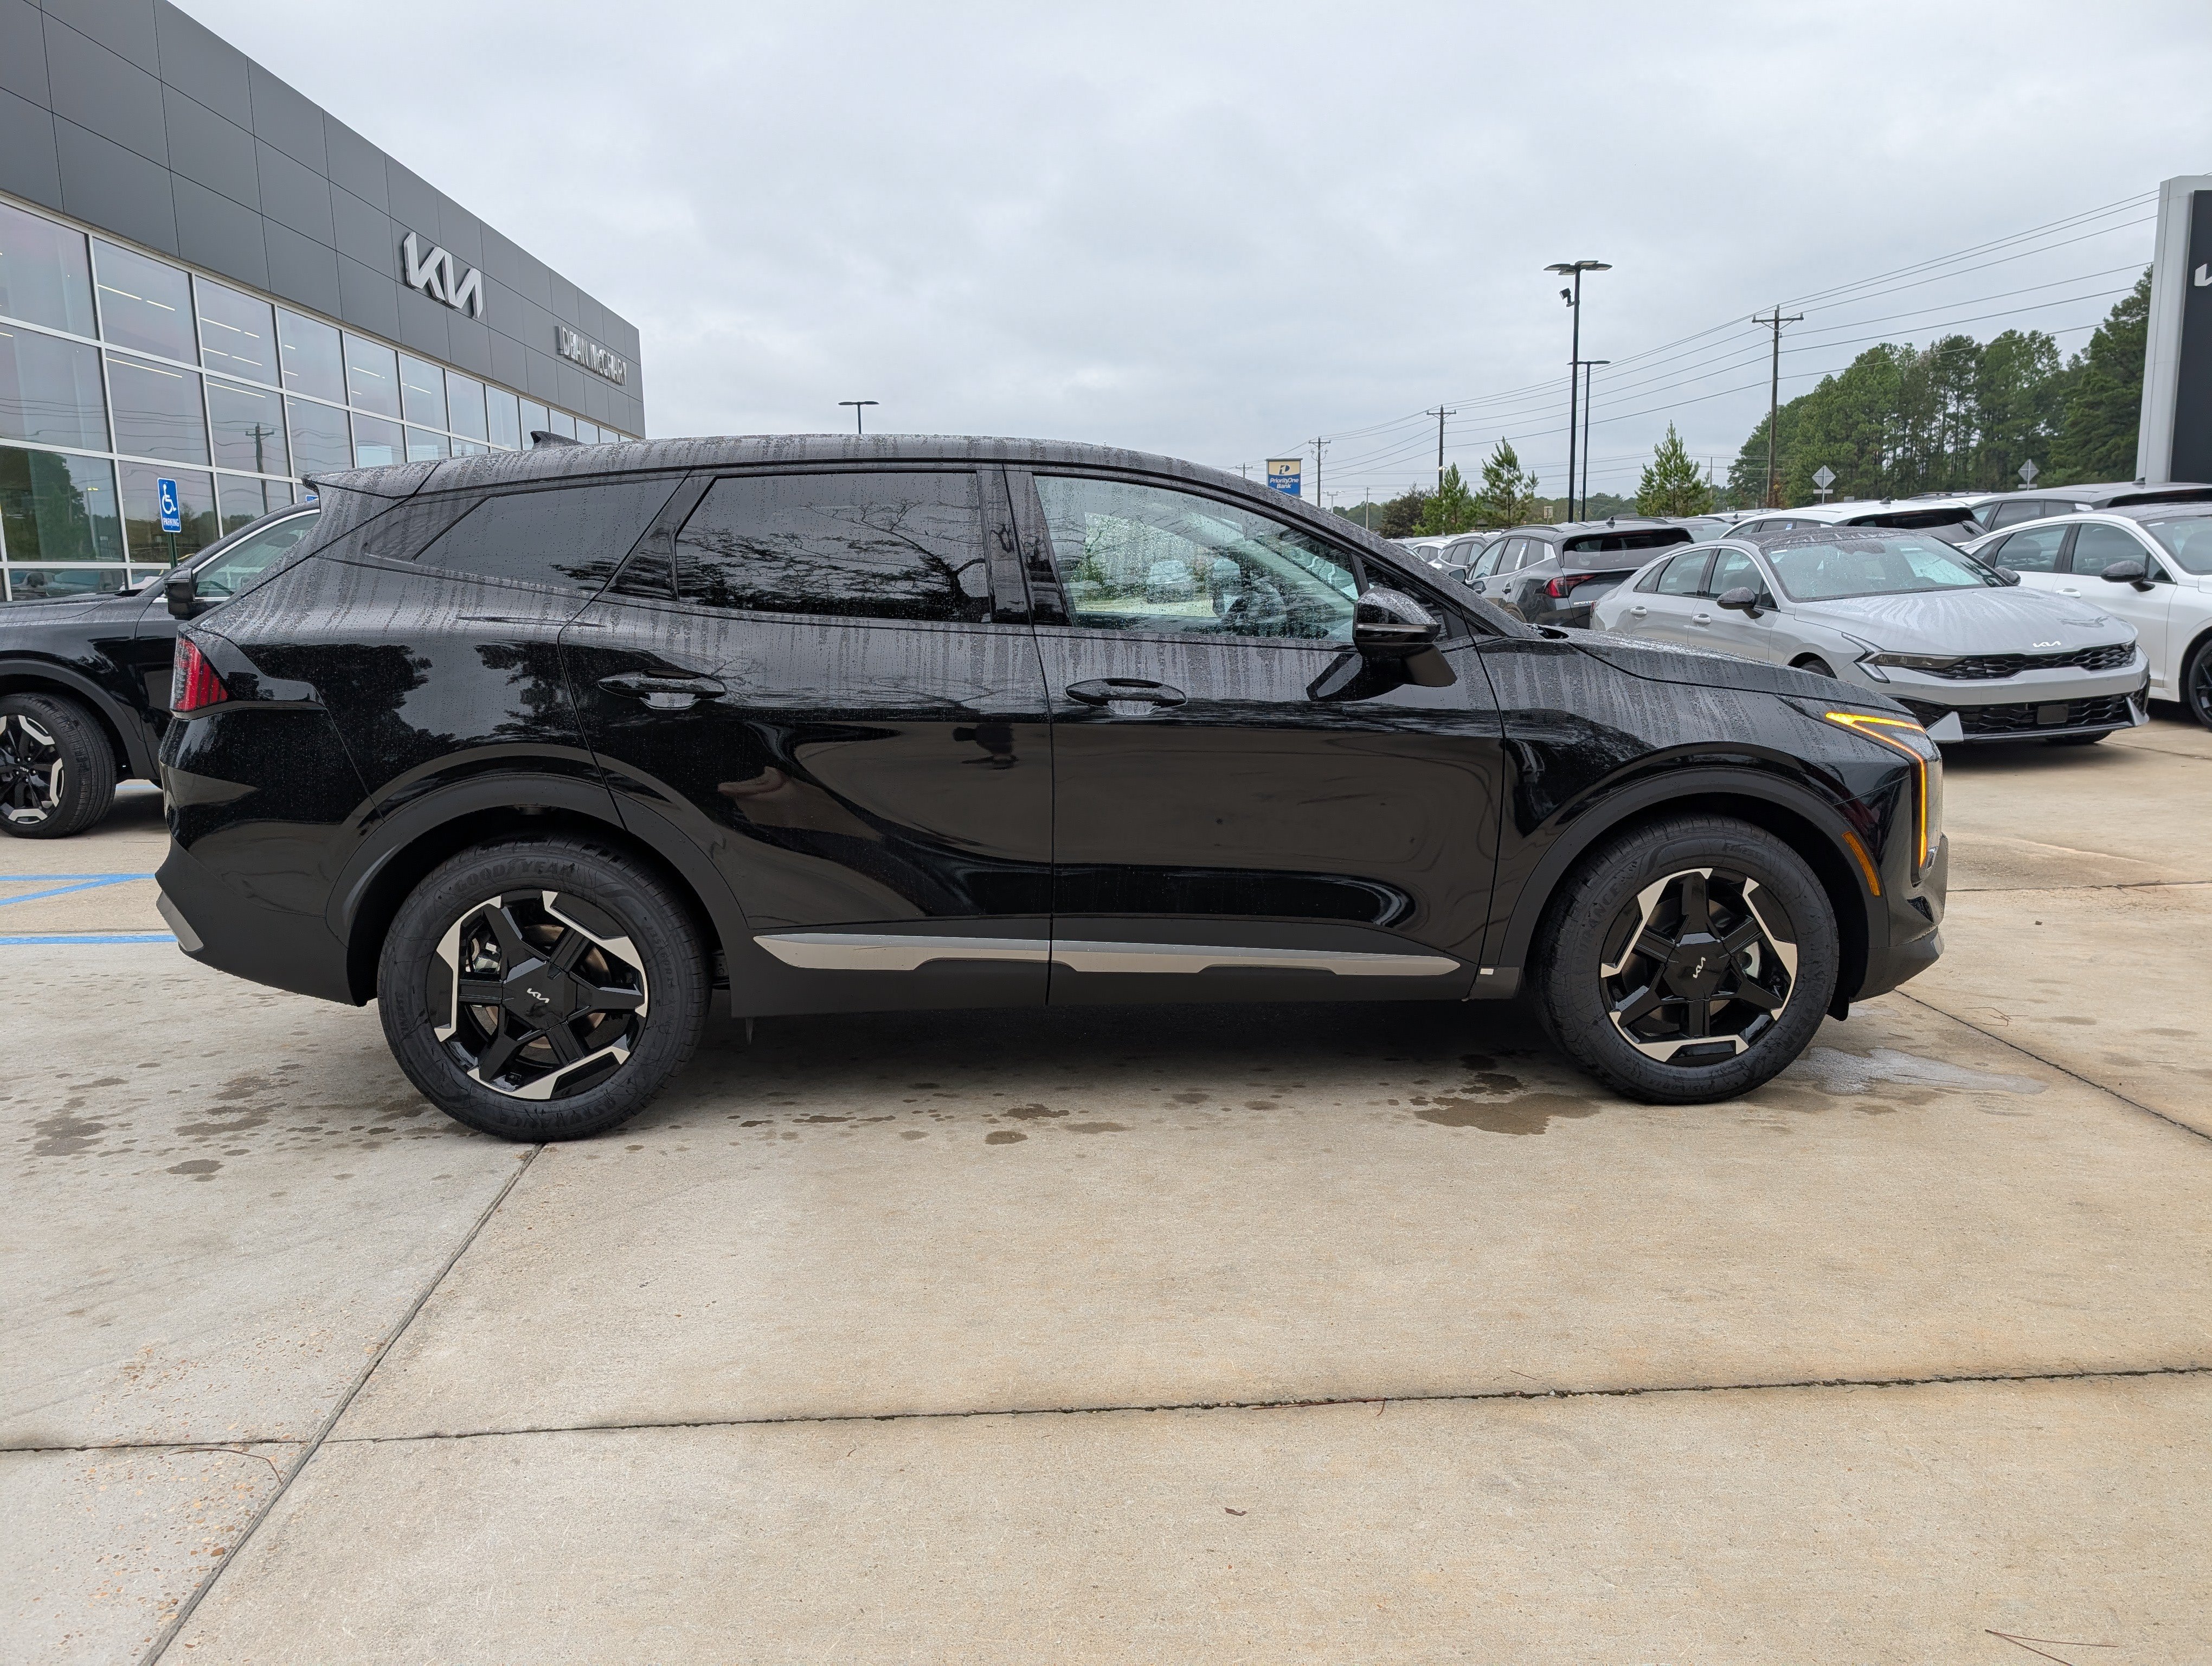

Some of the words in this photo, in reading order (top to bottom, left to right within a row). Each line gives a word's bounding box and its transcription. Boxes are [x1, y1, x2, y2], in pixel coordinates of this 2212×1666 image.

[403, 232, 483, 319] KIA
[558, 325, 590, 369] DEAN
[163, 517, 179, 527] PARKING
[1693, 957, 1706, 979] KIA
[526, 988, 550, 1003] KIA
